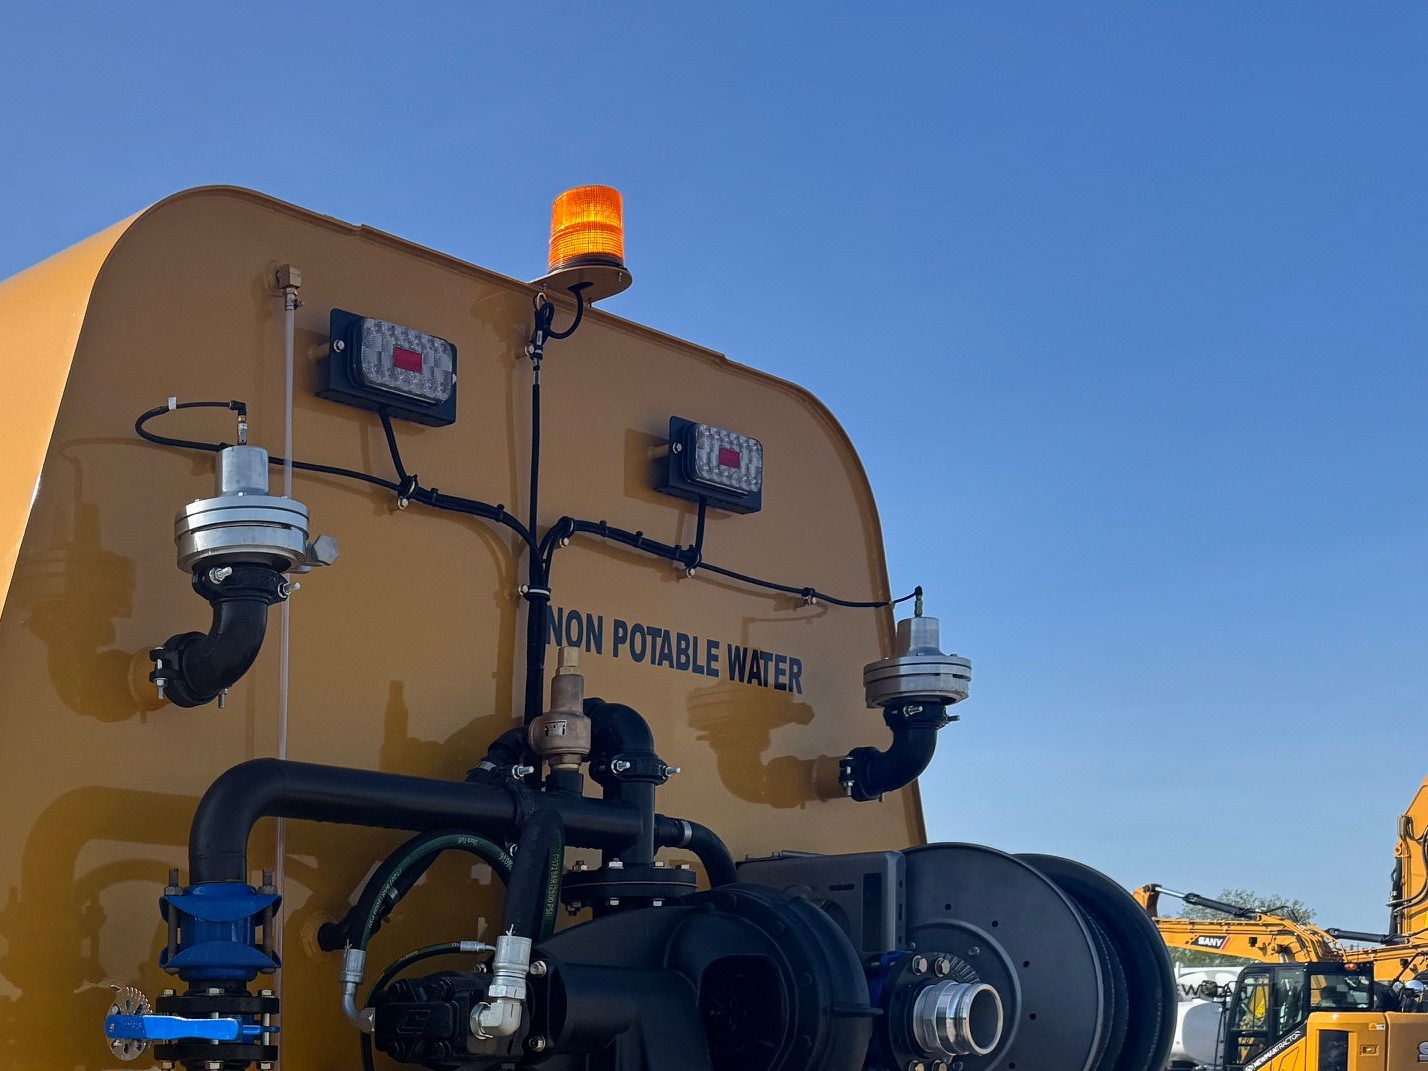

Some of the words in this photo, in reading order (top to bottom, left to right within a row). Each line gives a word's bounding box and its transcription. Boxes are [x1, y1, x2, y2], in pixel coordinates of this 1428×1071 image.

[545, 606, 603, 655] NON
[613, 618, 720, 678] POTABLE
[727, 643, 803, 694] WATER
[1197, 936, 1224, 947] SANY
